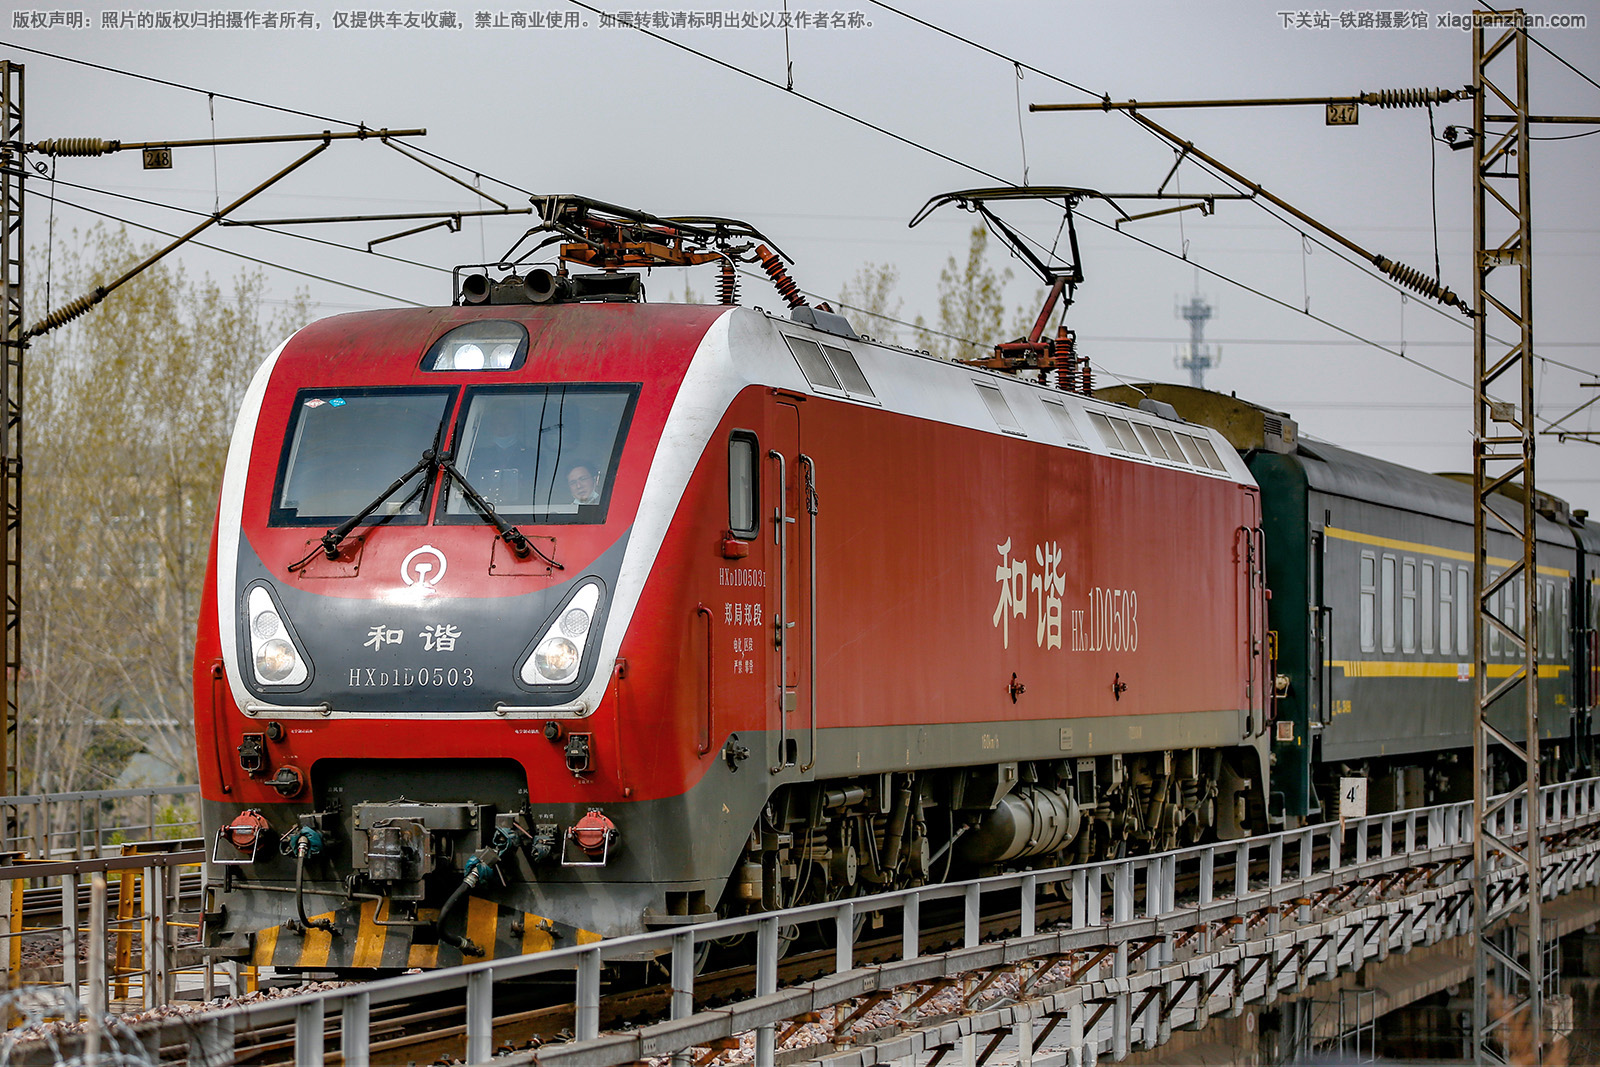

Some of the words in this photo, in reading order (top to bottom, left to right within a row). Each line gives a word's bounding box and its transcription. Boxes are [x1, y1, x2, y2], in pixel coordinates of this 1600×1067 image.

[1330, 106, 1356, 123] 247
[146, 151, 170, 167] 248
[993, 536, 1067, 651] 和谐
[724, 602, 762, 626] 郑局郑段
[363, 624, 463, 653] 和谐
[348, 667, 475, 688] HXD1D0503
